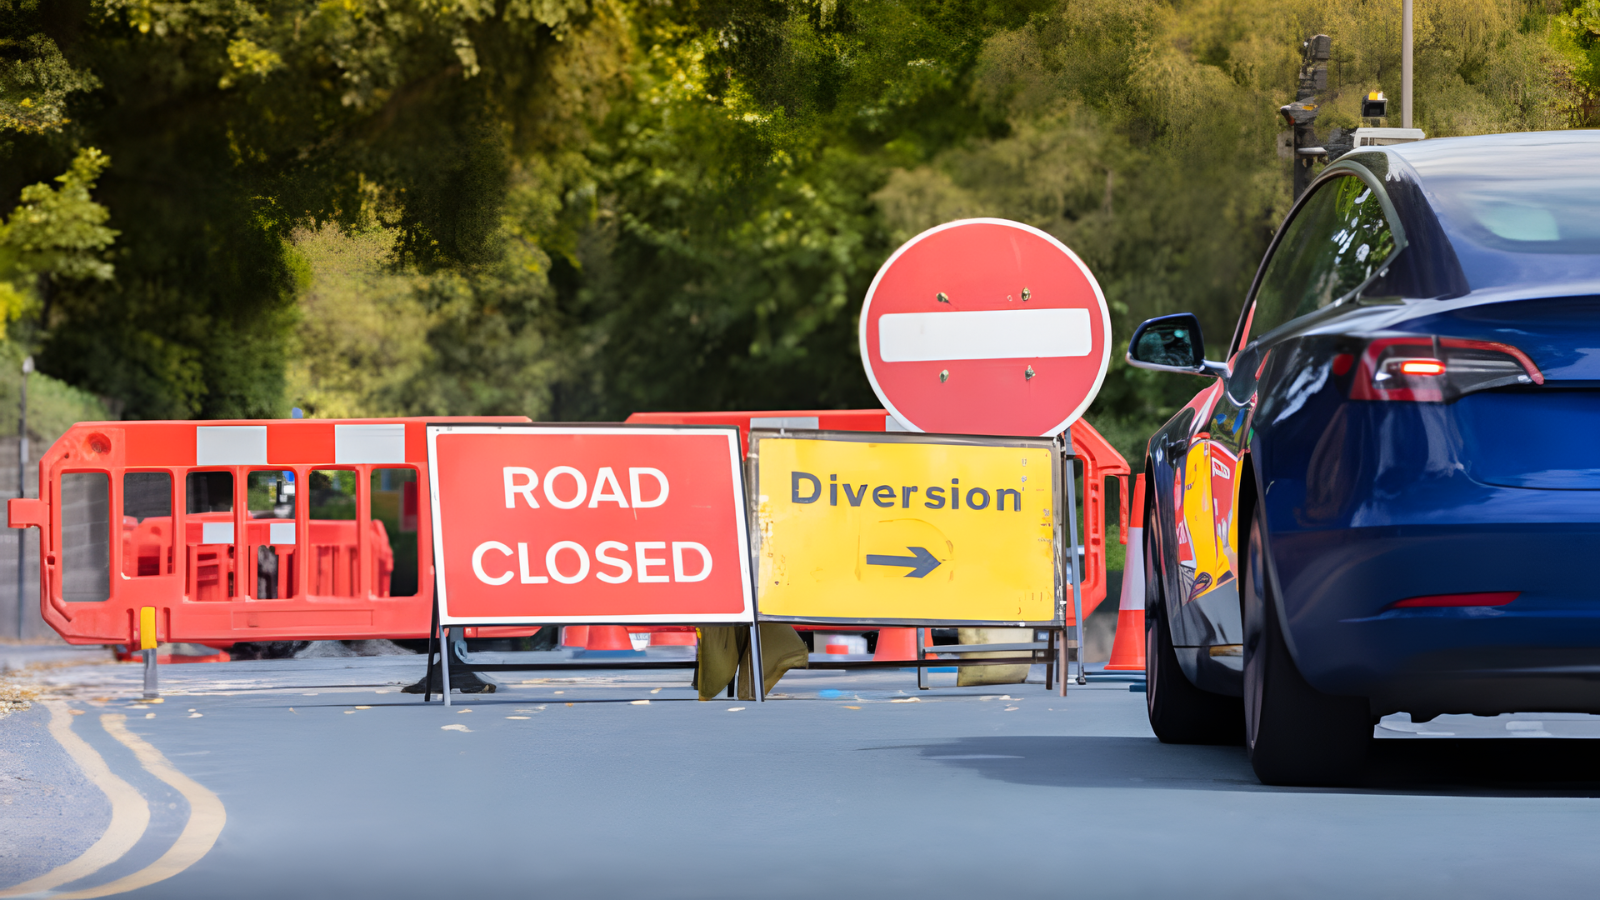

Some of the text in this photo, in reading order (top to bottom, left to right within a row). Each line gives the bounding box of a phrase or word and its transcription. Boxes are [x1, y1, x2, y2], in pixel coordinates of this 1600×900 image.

[503, 465, 670, 510] ROAD
[791, 471, 1022, 512] Diversion
[471, 540, 714, 586] CLOSED
